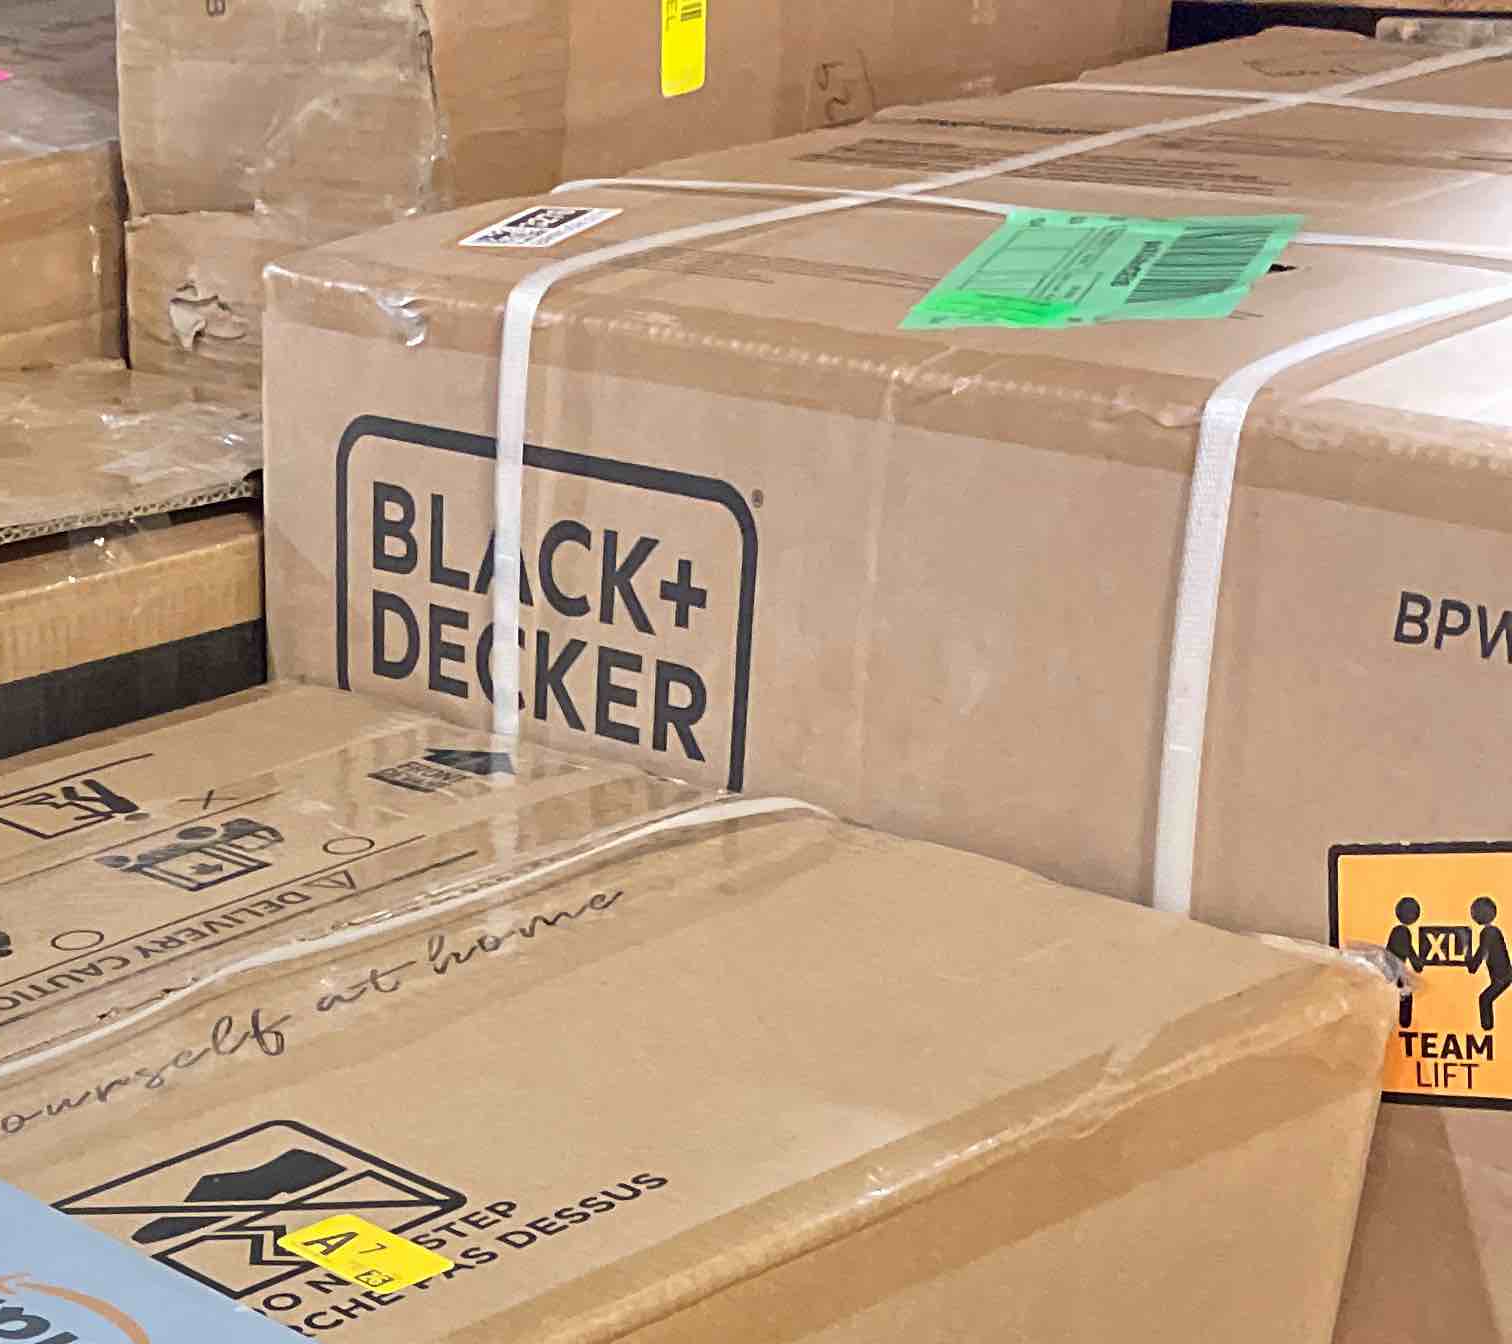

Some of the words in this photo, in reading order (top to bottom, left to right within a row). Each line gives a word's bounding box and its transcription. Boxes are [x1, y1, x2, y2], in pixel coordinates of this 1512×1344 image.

[372, 588, 706, 763] DECKER
[134, 891, 312, 959] DELIVERY
[316, 960, 417, 1012] at
[427, 890, 625, 975] home
[1425, 932, 1466, 962] XL
[1398, 1031, 1494, 1061] TEAM
[1416, 1060, 1480, 1089] LIFT
[408, 1200, 518, 1252] STEP
[497, 1172, 670, 1251] DESSUS
[303, 1231, 360, 1256] A
